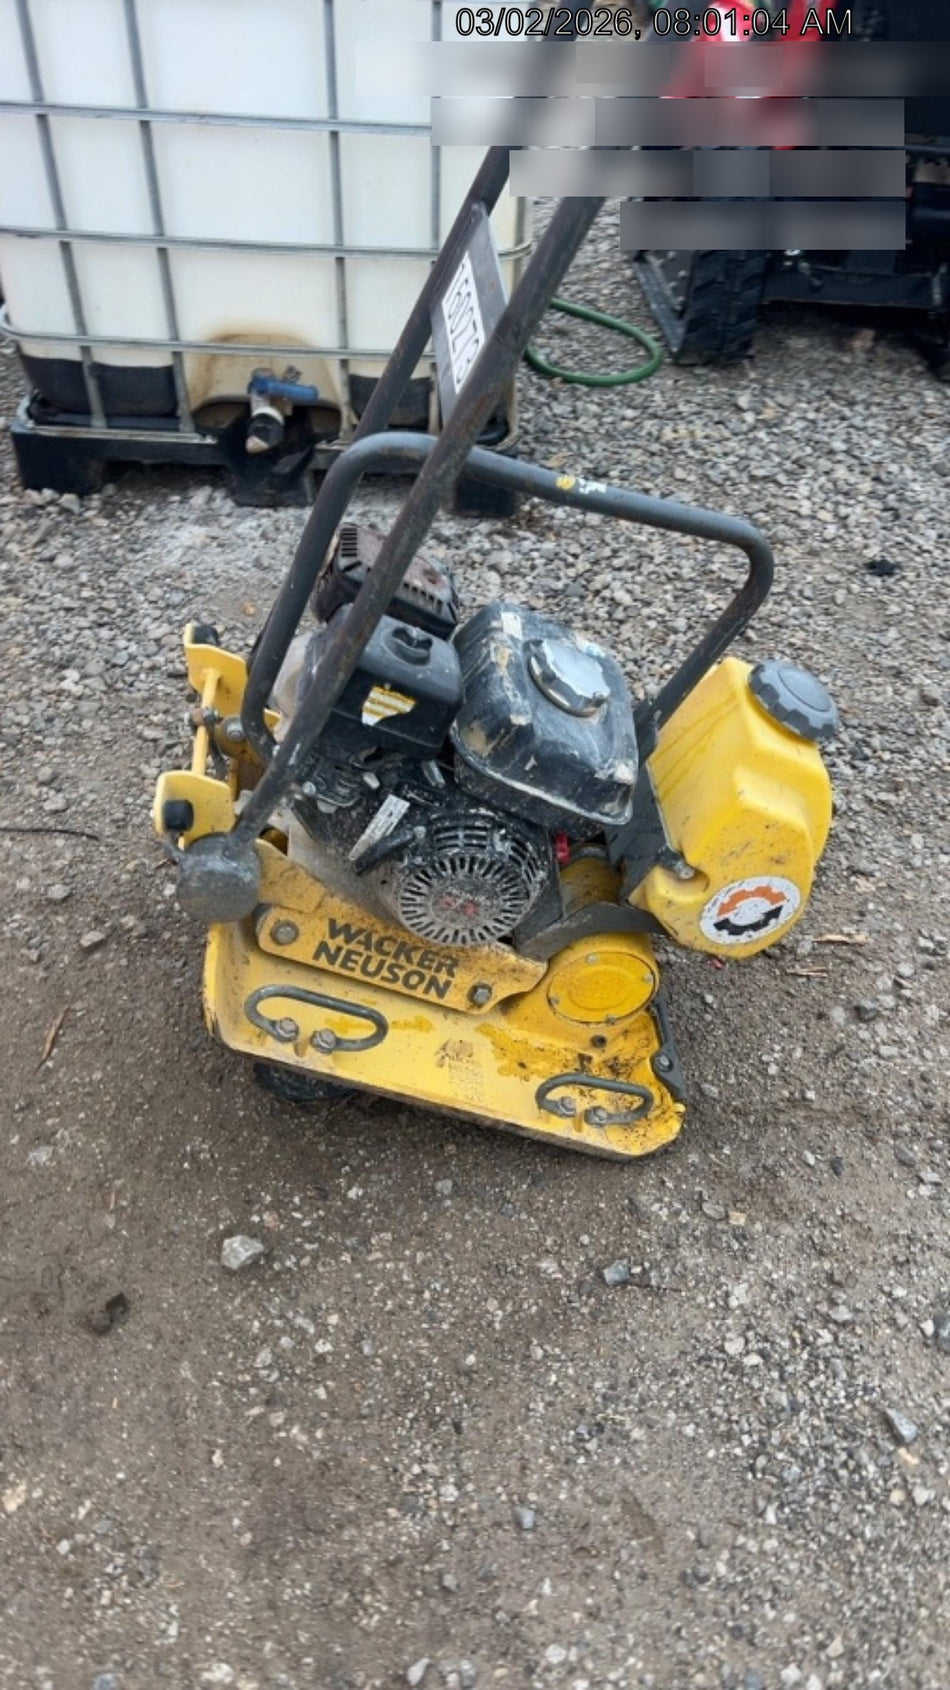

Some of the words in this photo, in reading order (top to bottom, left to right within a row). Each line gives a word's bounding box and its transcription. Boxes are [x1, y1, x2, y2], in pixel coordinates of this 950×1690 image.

[444, 260, 480, 386] 160273
[312, 940, 452, 999] NEUSON
[328, 917, 459, 978] WACKER
